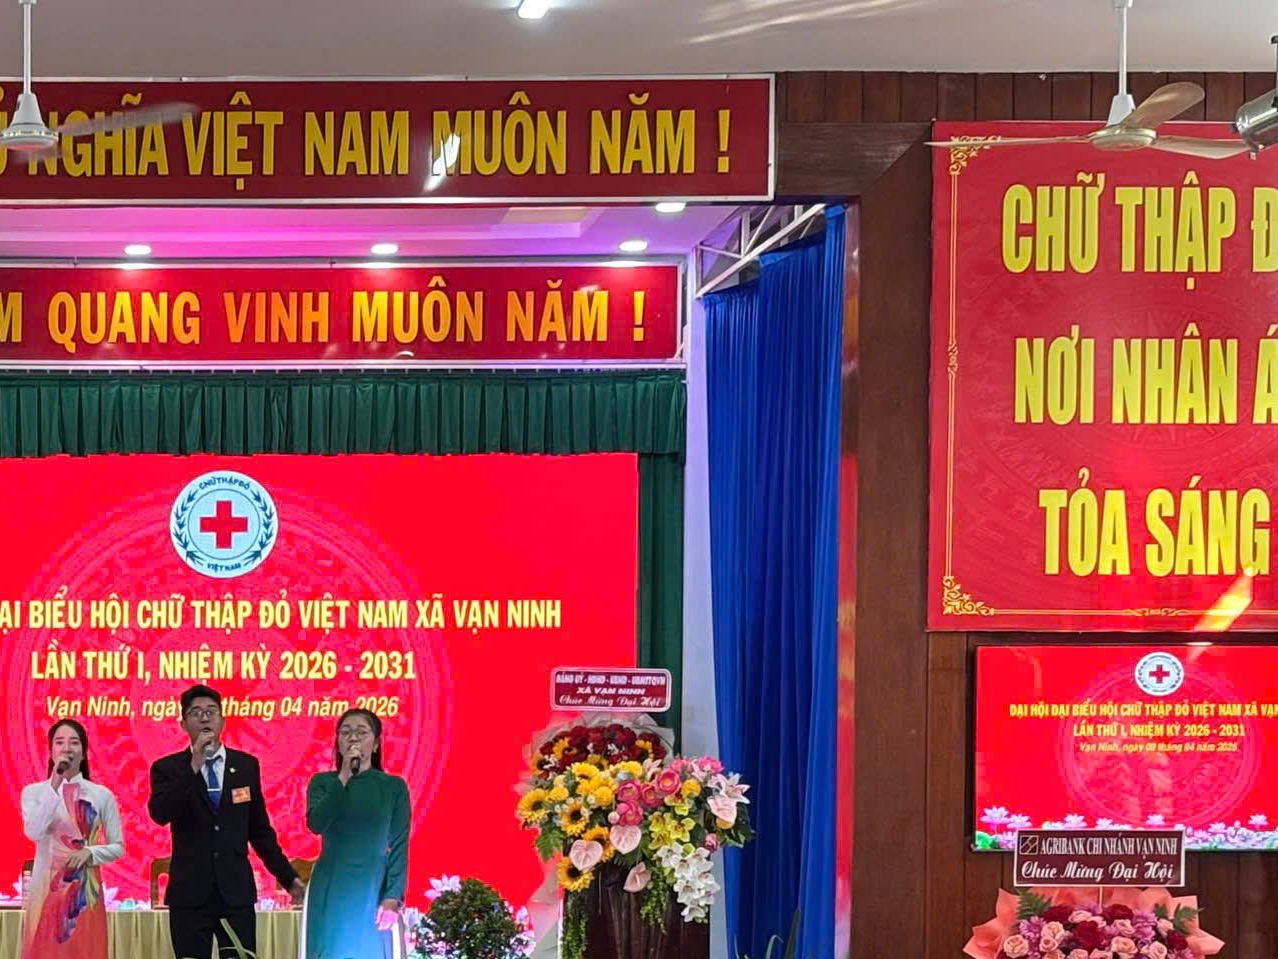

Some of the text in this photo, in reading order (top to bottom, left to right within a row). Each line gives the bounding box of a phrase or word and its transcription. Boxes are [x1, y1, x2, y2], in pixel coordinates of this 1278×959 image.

[28, 92, 169, 177] NGHĨA
[183, 92, 283, 190] VIỆT
[305, 111, 409, 175] NAM
[434, 91, 566, 175] MUÔN
[590, 93, 695, 174] NĂM
[718, 110, 730, 172] !
[1002, 172, 1105, 273] CHỮ
[1115, 171, 1236, 289] THẬP
[49, 292, 199, 353] QUANG
[225, 292, 330, 343] VINH
[353, 276, 482, 343] MUÔN
[507, 282, 608, 341] NĂM
[634, 291, 645, 341] !
[1015, 325, 1095, 425] NƠI
[1112, 323, 1238, 424] NHÂN
[1039, 468, 1271, 577] TỎA SÁNG
[224, 563, 241, 571] NAM
[29, 585, 82, 628] BIỂU
[90, 592, 129, 634] HỘI
[136, 592, 185, 629] CHỮ
[191, 593, 252, 634] THẬP
[259, 589, 291, 628] ĐỎ
[299, 592, 350, 634] VIỆT
[358, 600, 408, 628] NAM
[417, 593, 445, 628] XÃ
[453, 600, 499, 634] VẠN
[508, 600, 561, 628] NINH
[31, 638, 76, 679] LẦN
[83, 644, 131, 679] THỨ
[138, 651, 151, 685] I,
[159, 643, 233, 685] NHIỆM
[241, 643, 272, 679] KỲ
[280, 651, 337, 679] 2026
[359, 651, 416, 679] 2031
[47, 696, 81, 720] Vạn
[88, 696, 135, 720] Ninh,
[142, 696, 183, 722] ngày
[222, 696, 276, 722] tháng
[281, 696, 302, 717] 04
[308, 696, 349, 716] năm
[1040, 833, 1178, 859] AGRIBANK CHI NHÁNH VẠN NINH
[1022, 861, 1174, 882] Chúc Mừng Đại Hội
